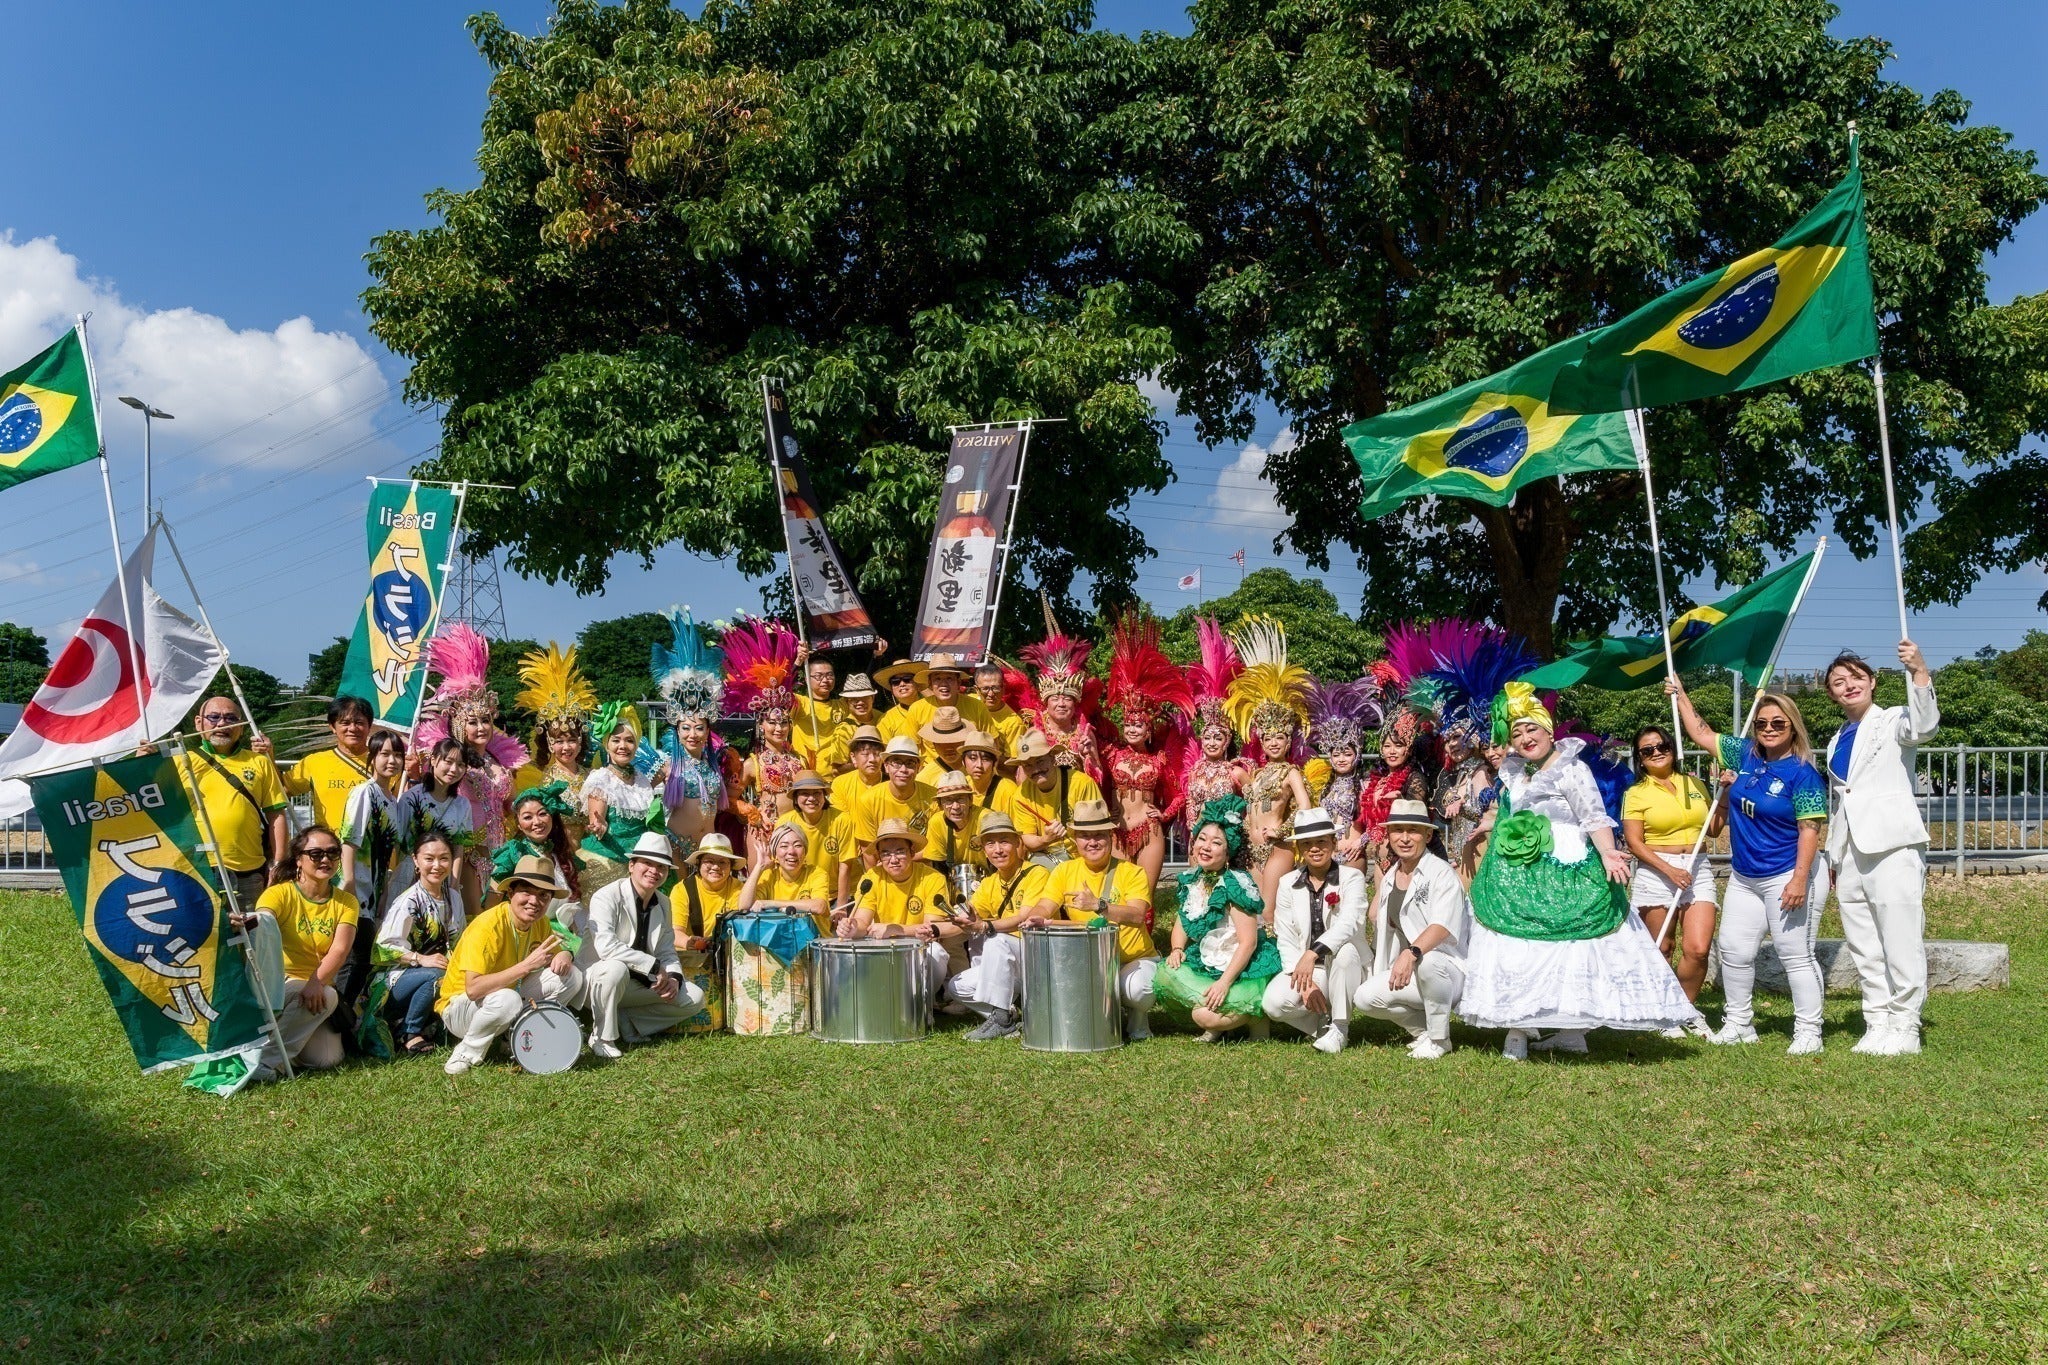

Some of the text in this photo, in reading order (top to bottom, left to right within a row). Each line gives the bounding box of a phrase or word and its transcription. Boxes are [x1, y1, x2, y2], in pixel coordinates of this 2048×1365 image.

[831, 634, 874, 648] 新里酒造
[1740, 797, 1756, 820] 10
